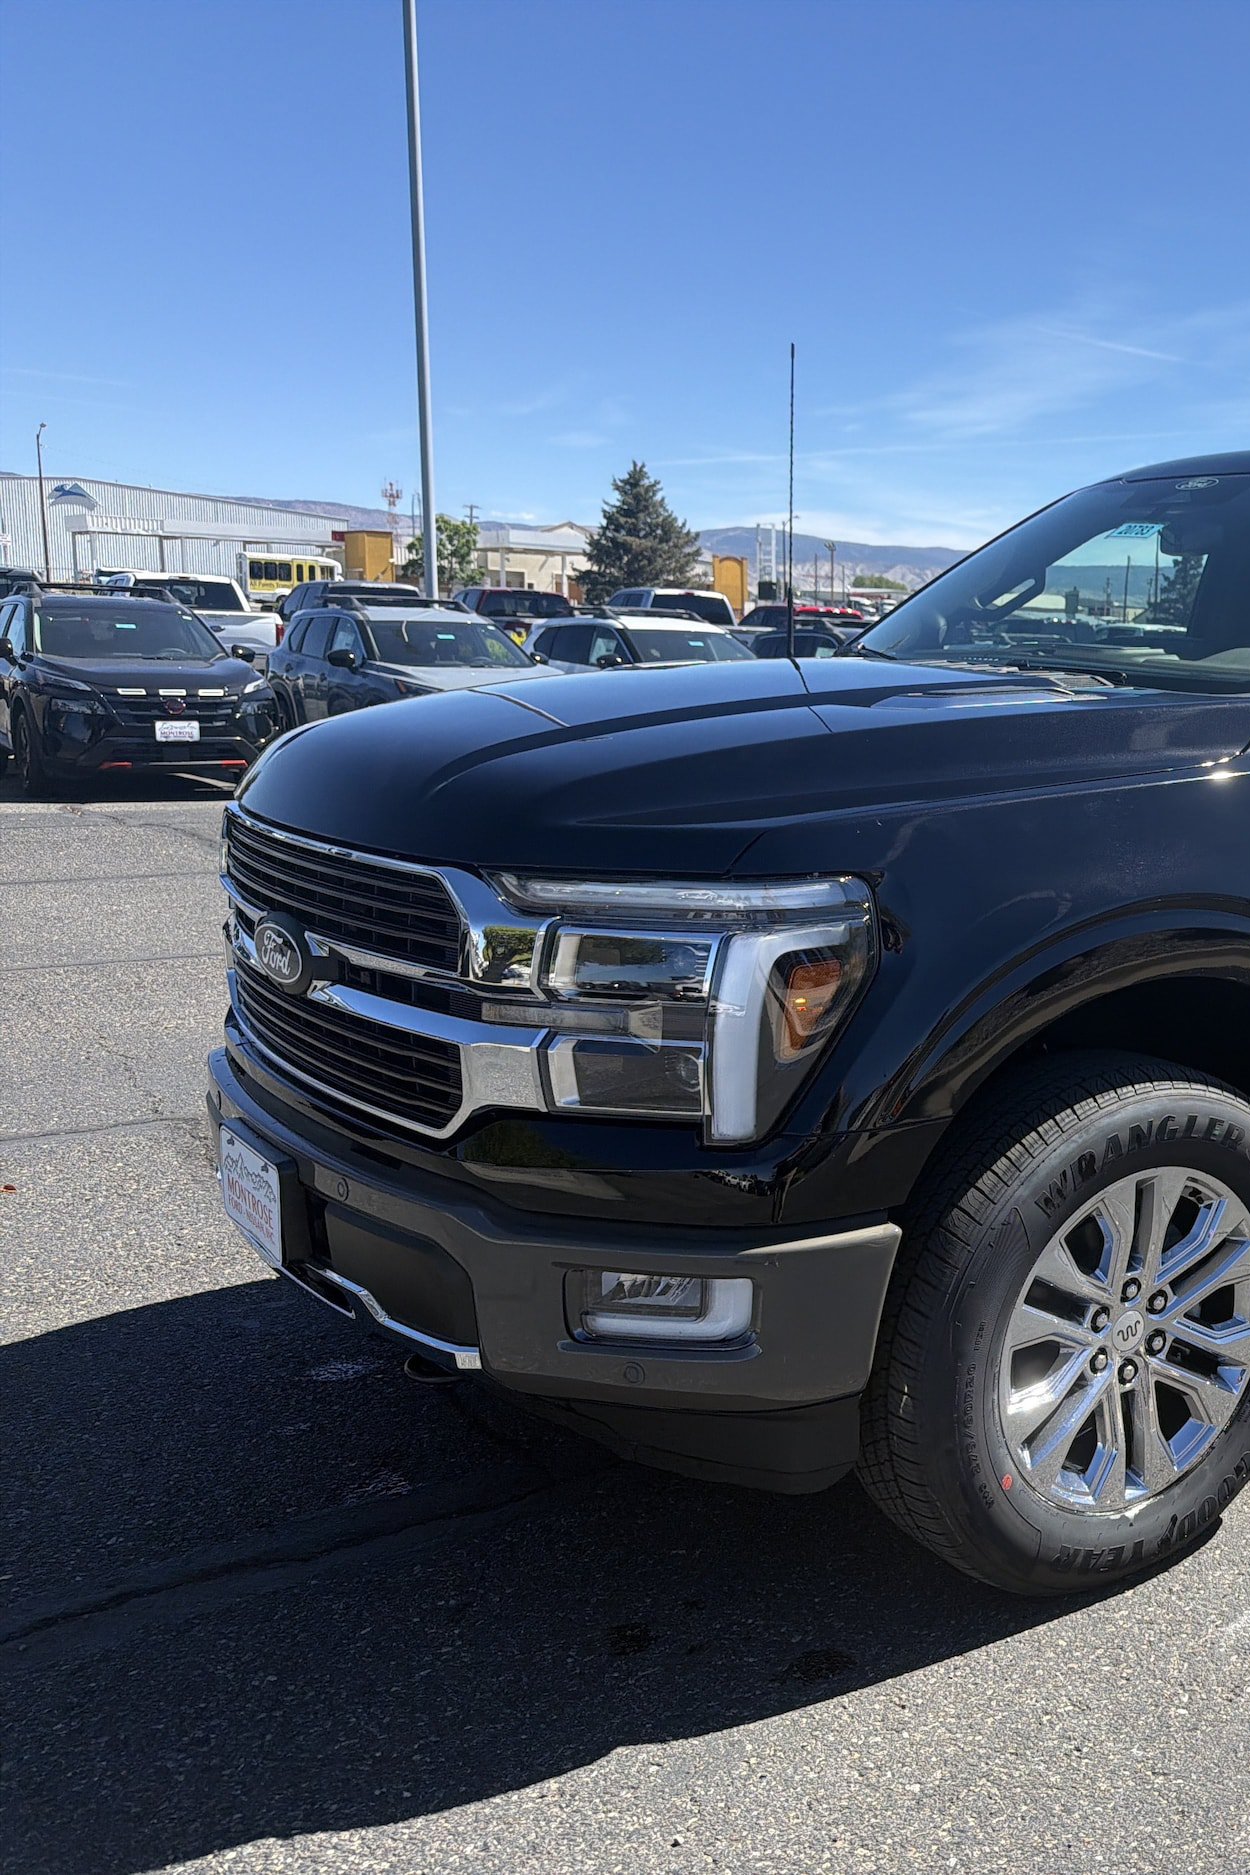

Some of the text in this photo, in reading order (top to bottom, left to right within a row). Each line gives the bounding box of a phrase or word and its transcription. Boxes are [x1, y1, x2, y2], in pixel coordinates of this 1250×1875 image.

[261, 929, 291, 975] Ford
[1033, 1113, 1247, 1208] WRANGLER
[227, 1172, 274, 1231] MONTROSE
